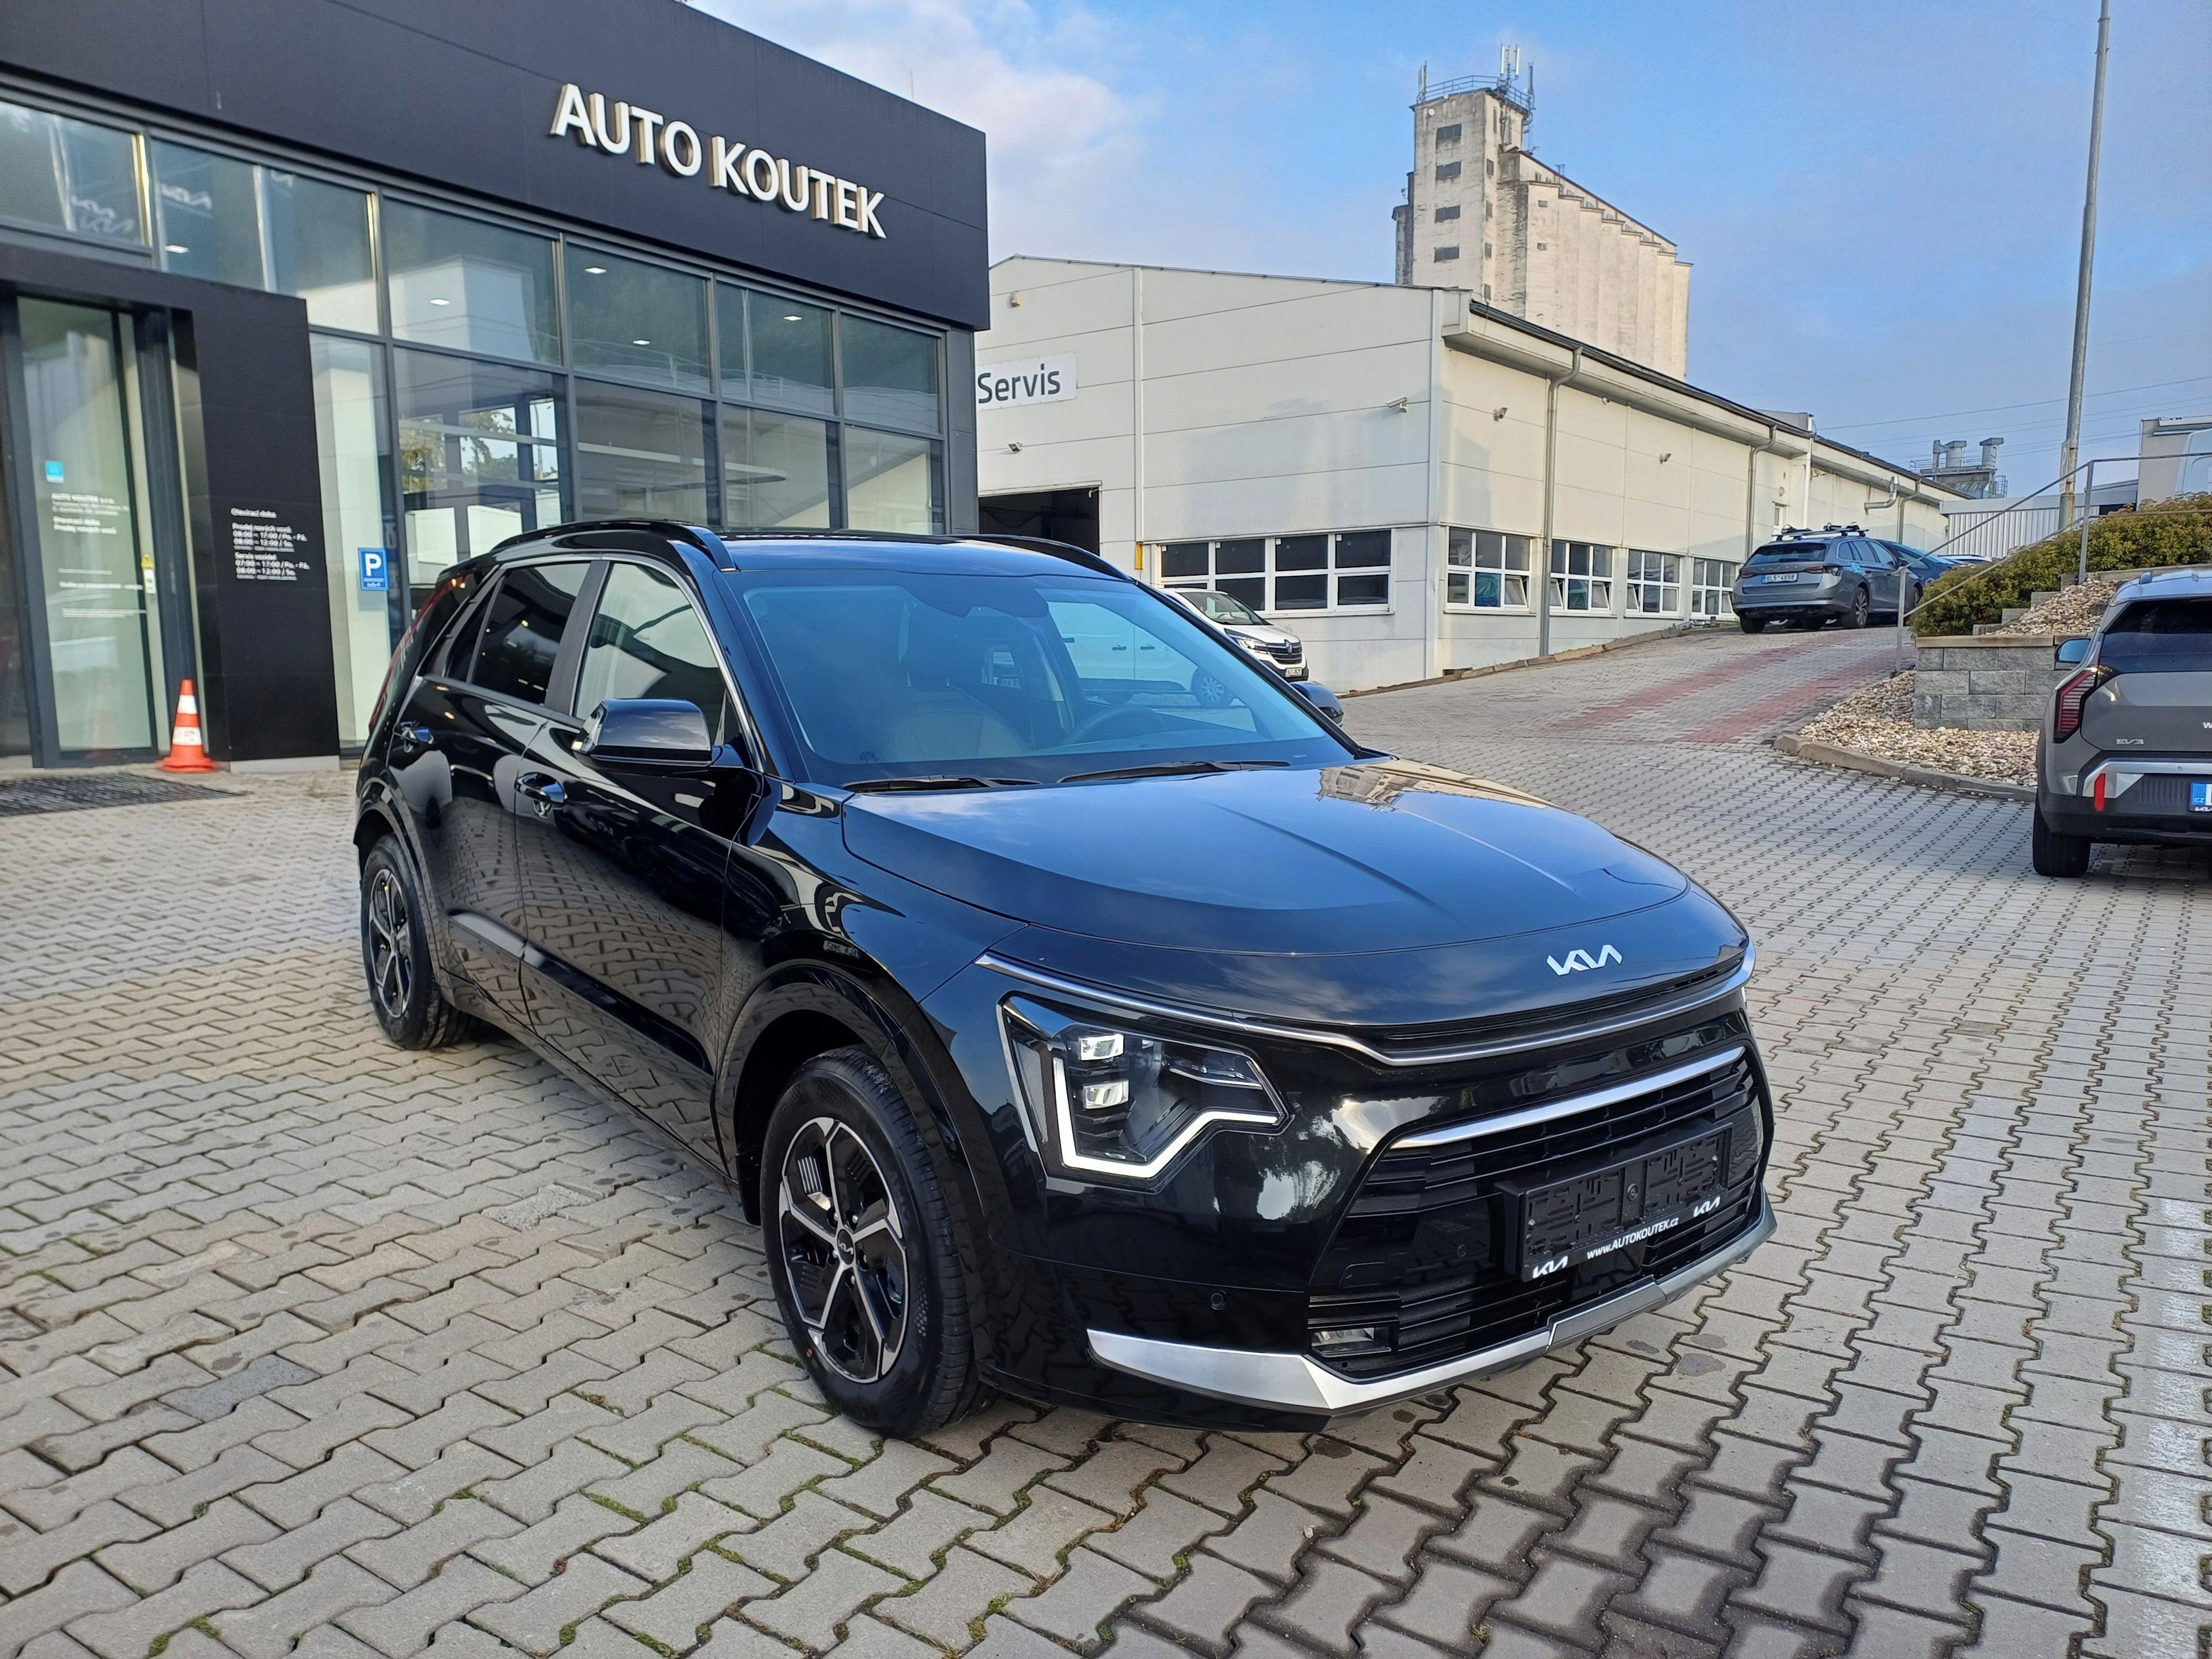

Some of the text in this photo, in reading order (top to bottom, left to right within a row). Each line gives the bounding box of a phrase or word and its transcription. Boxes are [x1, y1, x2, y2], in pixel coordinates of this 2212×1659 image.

[550, 82, 886, 238] AUTO KOUTEK
[977, 363, 1061, 404] Servis
[364, 553, 382, 576] P
[1547, 944, 1623, 976] KIA
[1693, 1196, 1720, 1218] KIA
[1587, 1217, 1679, 1259] www.AUTOKOUTEK.cz
[1532, 1255, 1568, 1279] KIA
